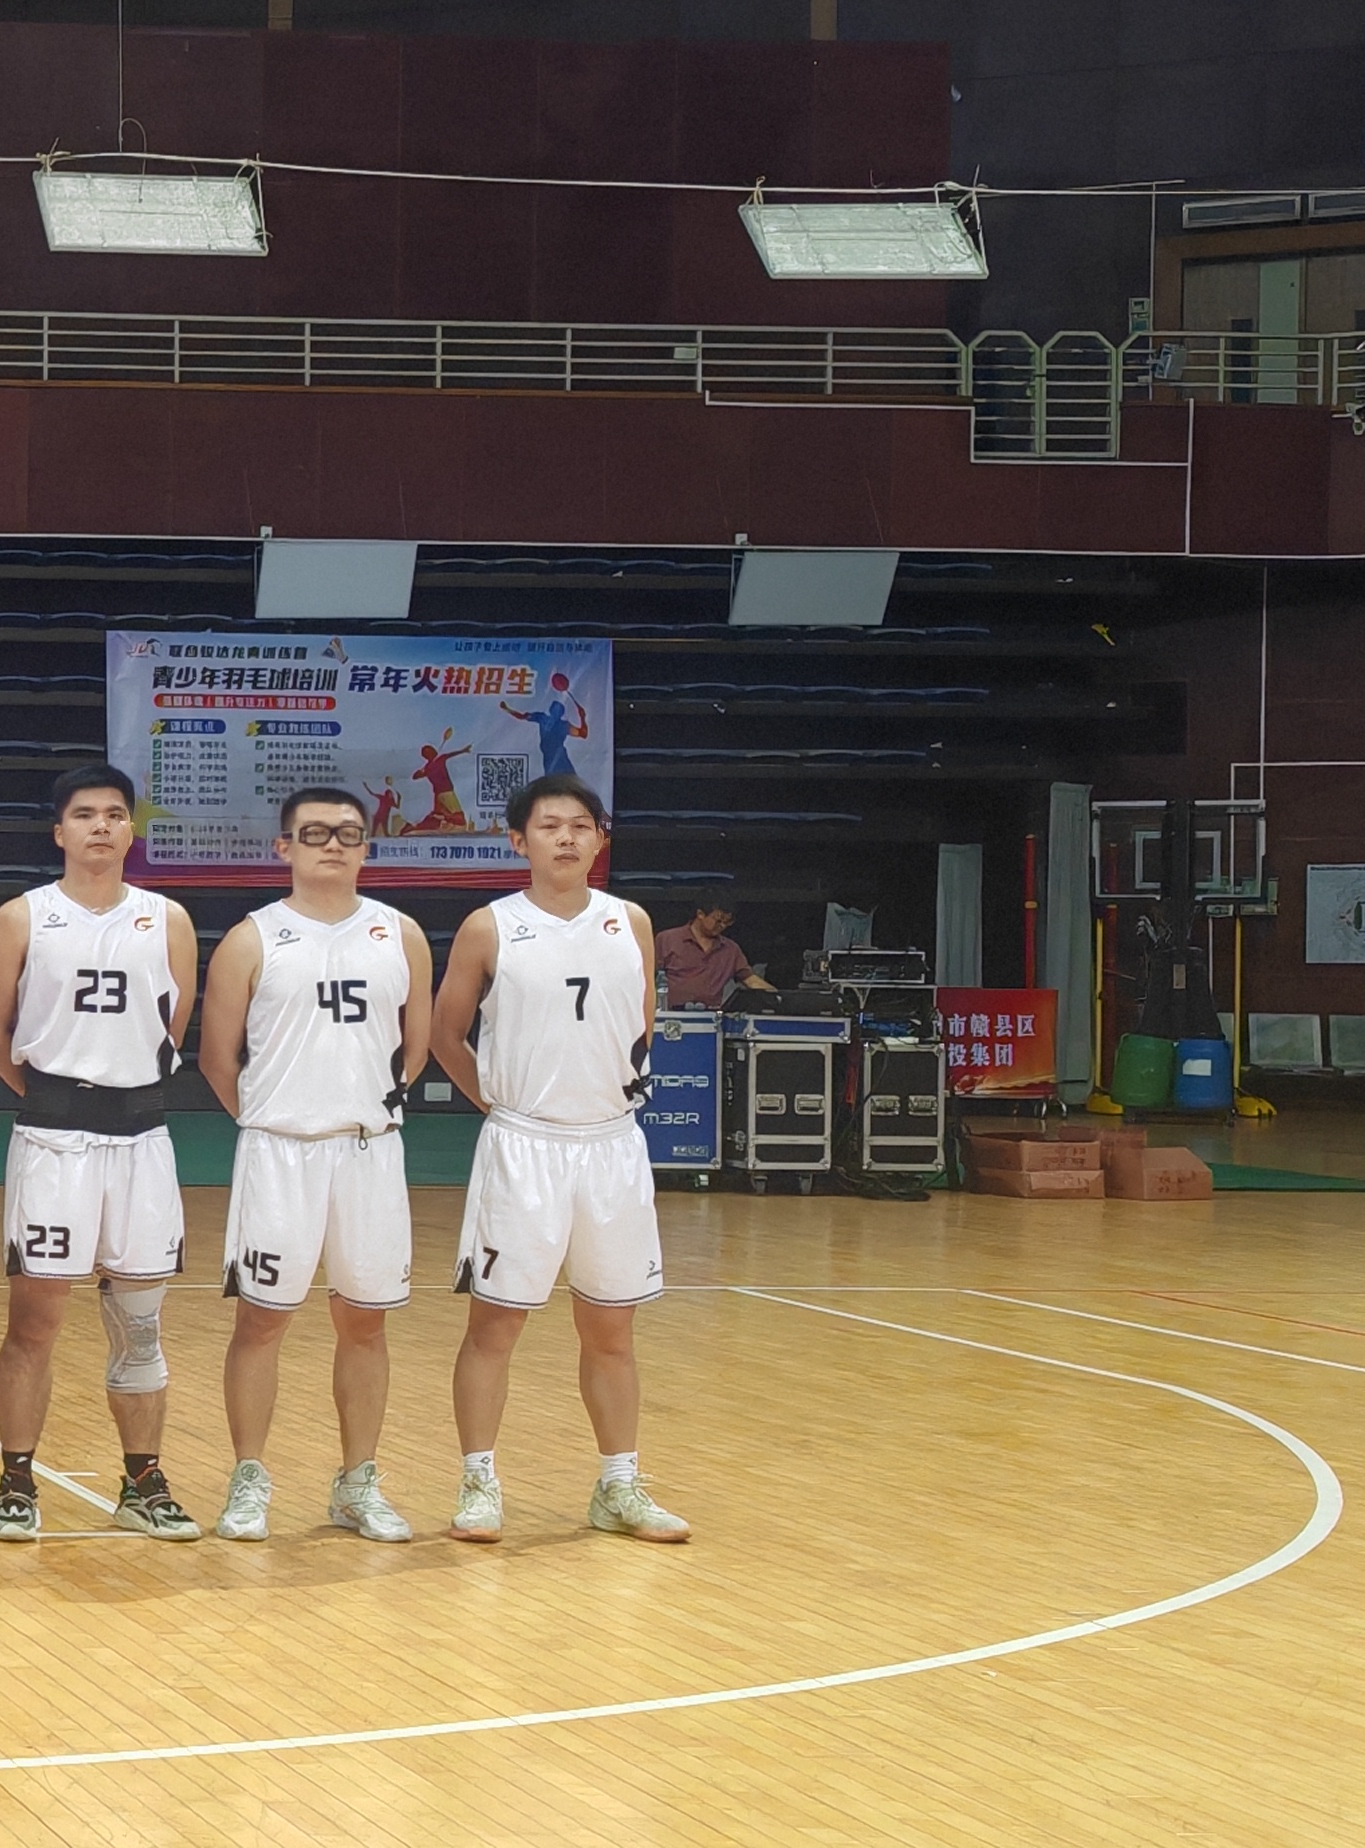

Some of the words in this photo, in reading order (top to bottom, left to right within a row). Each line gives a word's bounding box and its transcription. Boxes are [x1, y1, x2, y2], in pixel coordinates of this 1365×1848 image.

[152, 665, 339, 692] 青少年羽毛球培训
[347, 666, 536, 695] 常年火热招生
[73, 968, 128, 1014] 23
[316, 979, 368, 1024] 45
[565, 977, 590, 1021] 7
[26, 1224, 70, 1260] 23
[481, 1246, 499, 1280] 7
[243, 1245, 282, 1288] 45
